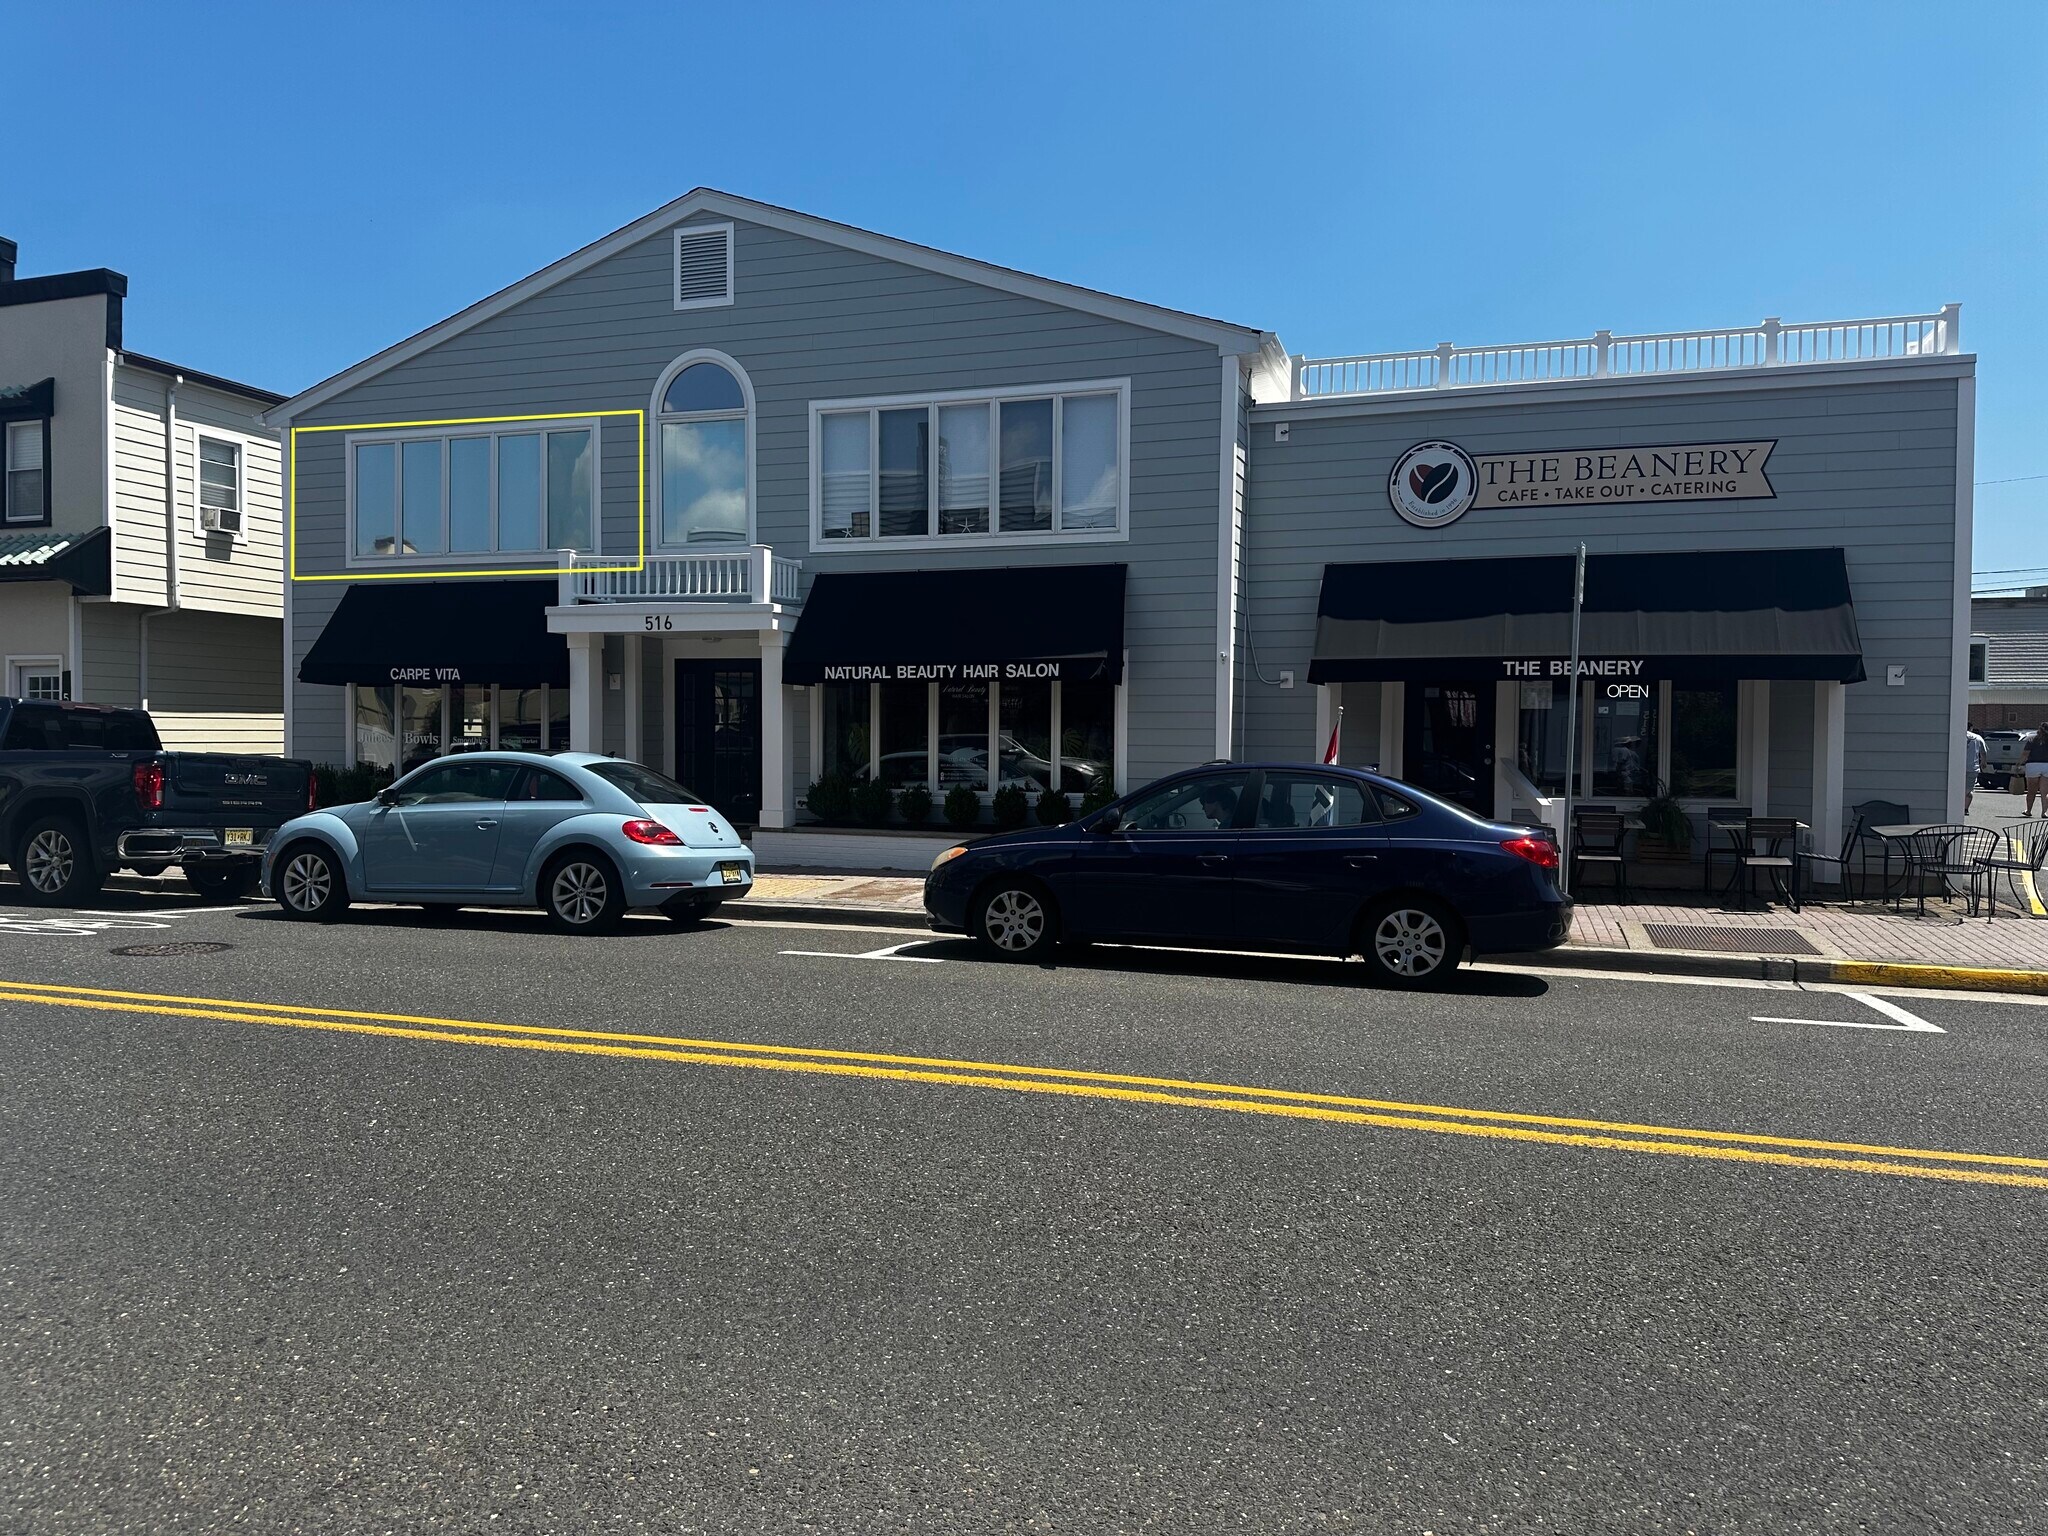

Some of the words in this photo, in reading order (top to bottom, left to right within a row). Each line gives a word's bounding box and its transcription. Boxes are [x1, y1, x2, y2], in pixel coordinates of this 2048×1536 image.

[1481, 458, 1560, 485] THE
[1574, 448, 1758, 482] BEANERY
[1498, 488, 1539, 502] CAFE
[1555, 486, 1595, 500] TAKE
[1600, 484, 1635, 498] OUT
[1651, 480, 1738, 496] CATERING
[645, 615, 672, 631] 516
[390, 668, 431, 680] CARPE
[435, 668, 461, 680] VITA
[824, 666, 891, 679] NATURAL
[896, 665, 957, 679] BEAUTY
[963, 664, 998, 678] HAIR
[1005, 663, 1060, 678] SALON
[1502, 661, 1541, 676] THE
[1550, 660, 1644, 676] BEANERY
[1606, 684, 1649, 698] OPEN
[405, 732, 439, 744] Bowls
[225, 773, 268, 785] GMC
